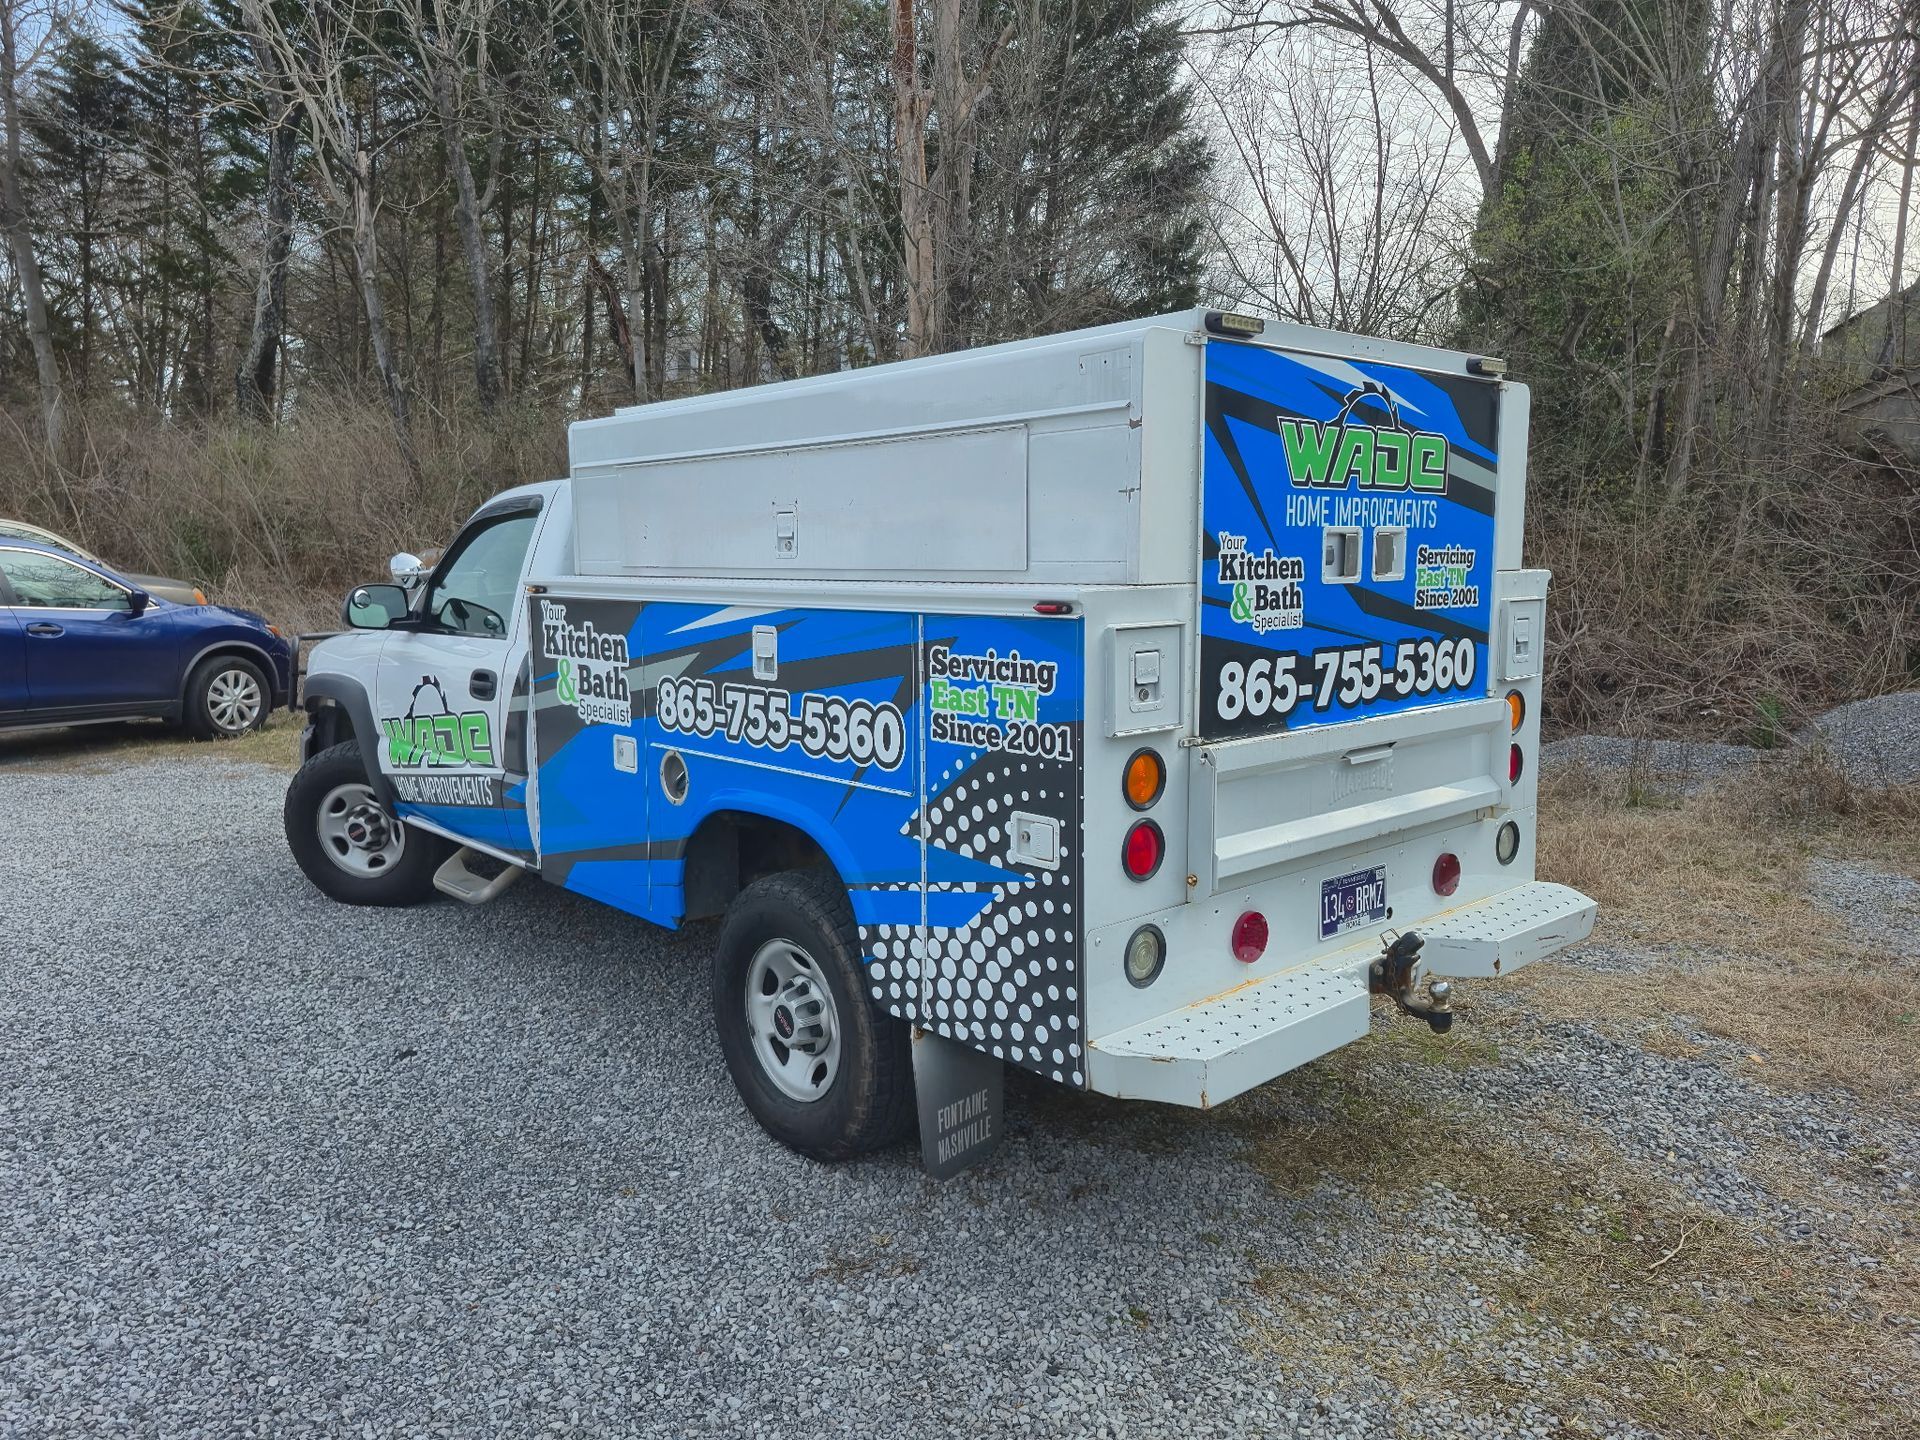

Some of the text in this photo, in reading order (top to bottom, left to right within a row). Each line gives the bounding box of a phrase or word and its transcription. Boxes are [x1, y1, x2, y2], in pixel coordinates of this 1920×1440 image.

[1286, 495, 1437, 529] HOME IMPROVEMENTS
[1220, 534, 1245, 550] Your
[1417, 546, 1475, 569] Servicing
[1220, 551, 1303, 580] Kitchen
[1416, 567, 1466, 586] East TN
[541, 602, 566, 621] Your
[1232, 581, 1302, 620] & Bath
[1415, 587, 1478, 607] Since 2001
[1254, 612, 1302, 632] Specialist
[544, 623, 628, 663] Kitchen
[558, 658, 629, 703] & Bath
[931, 648, 1056, 693] Servicing
[1217, 637, 1475, 720] 865-755-5360
[579, 698, 630, 723] Specialist
[931, 681, 1038, 720] East TN
[660, 679, 902, 764] 865-755-5360
[932, 712, 1071, 758] Since 2001
[394, 775, 494, 806] HOME IMPROVEMENTS
[1323, 892, 1345, 924] 134
[1355, 880, 1384, 914] BRMZ
[937, 1088, 988, 1133] FONTAINE
[937, 1115, 992, 1165] NASHVILLE
